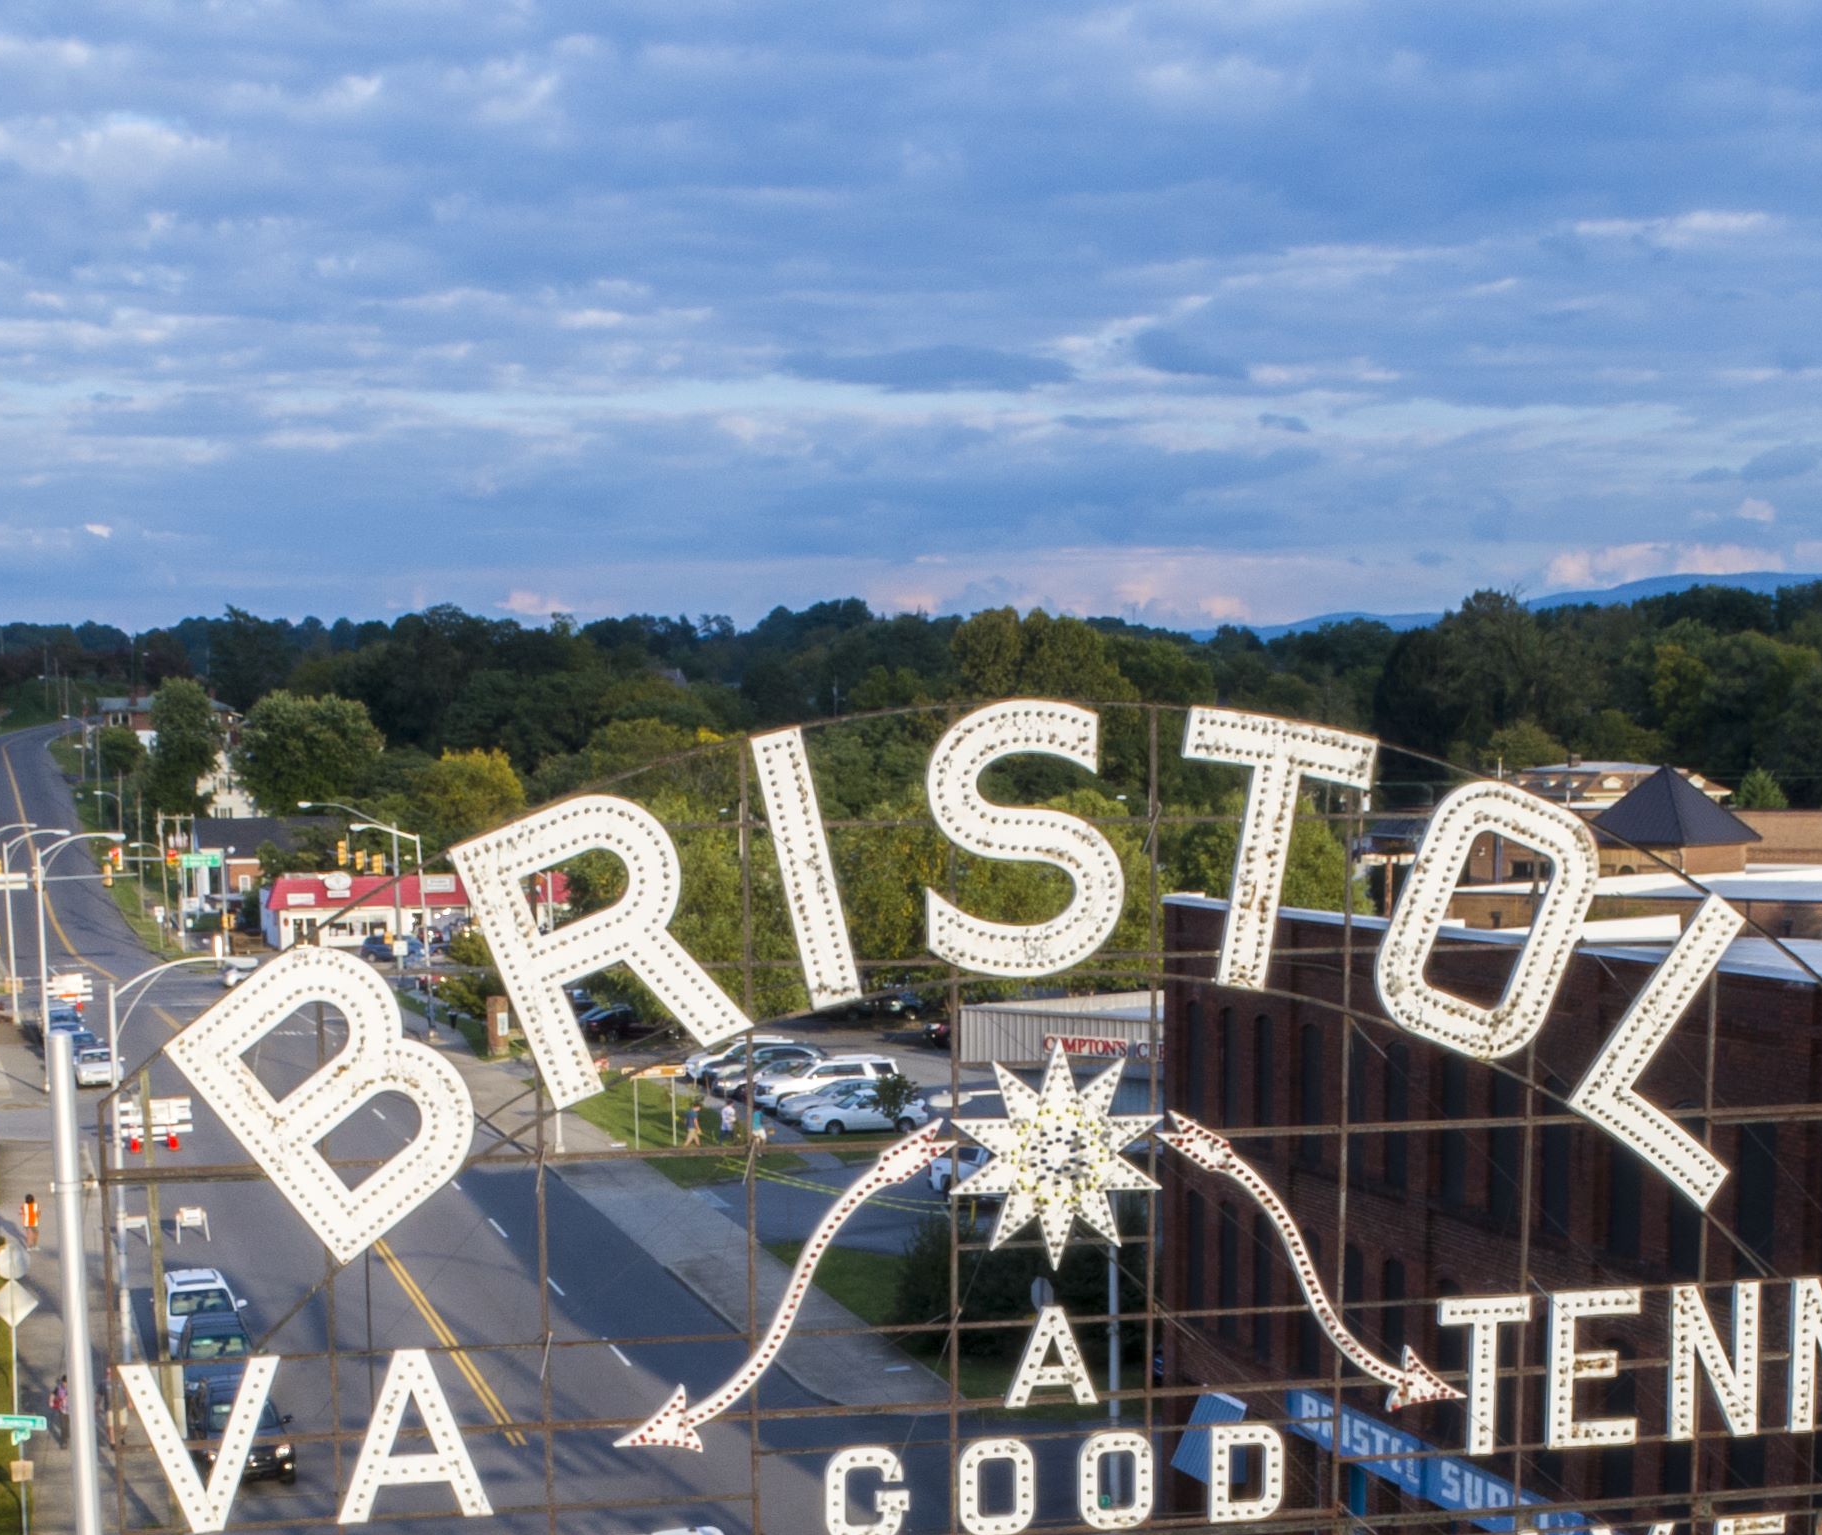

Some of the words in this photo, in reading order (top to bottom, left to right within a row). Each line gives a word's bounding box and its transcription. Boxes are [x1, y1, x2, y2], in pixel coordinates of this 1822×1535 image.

[164, 698, 1745, 1264] BRISTOL
[117, 1349, 494, 1535] VA
[1005, 1306, 1099, 1407] A
